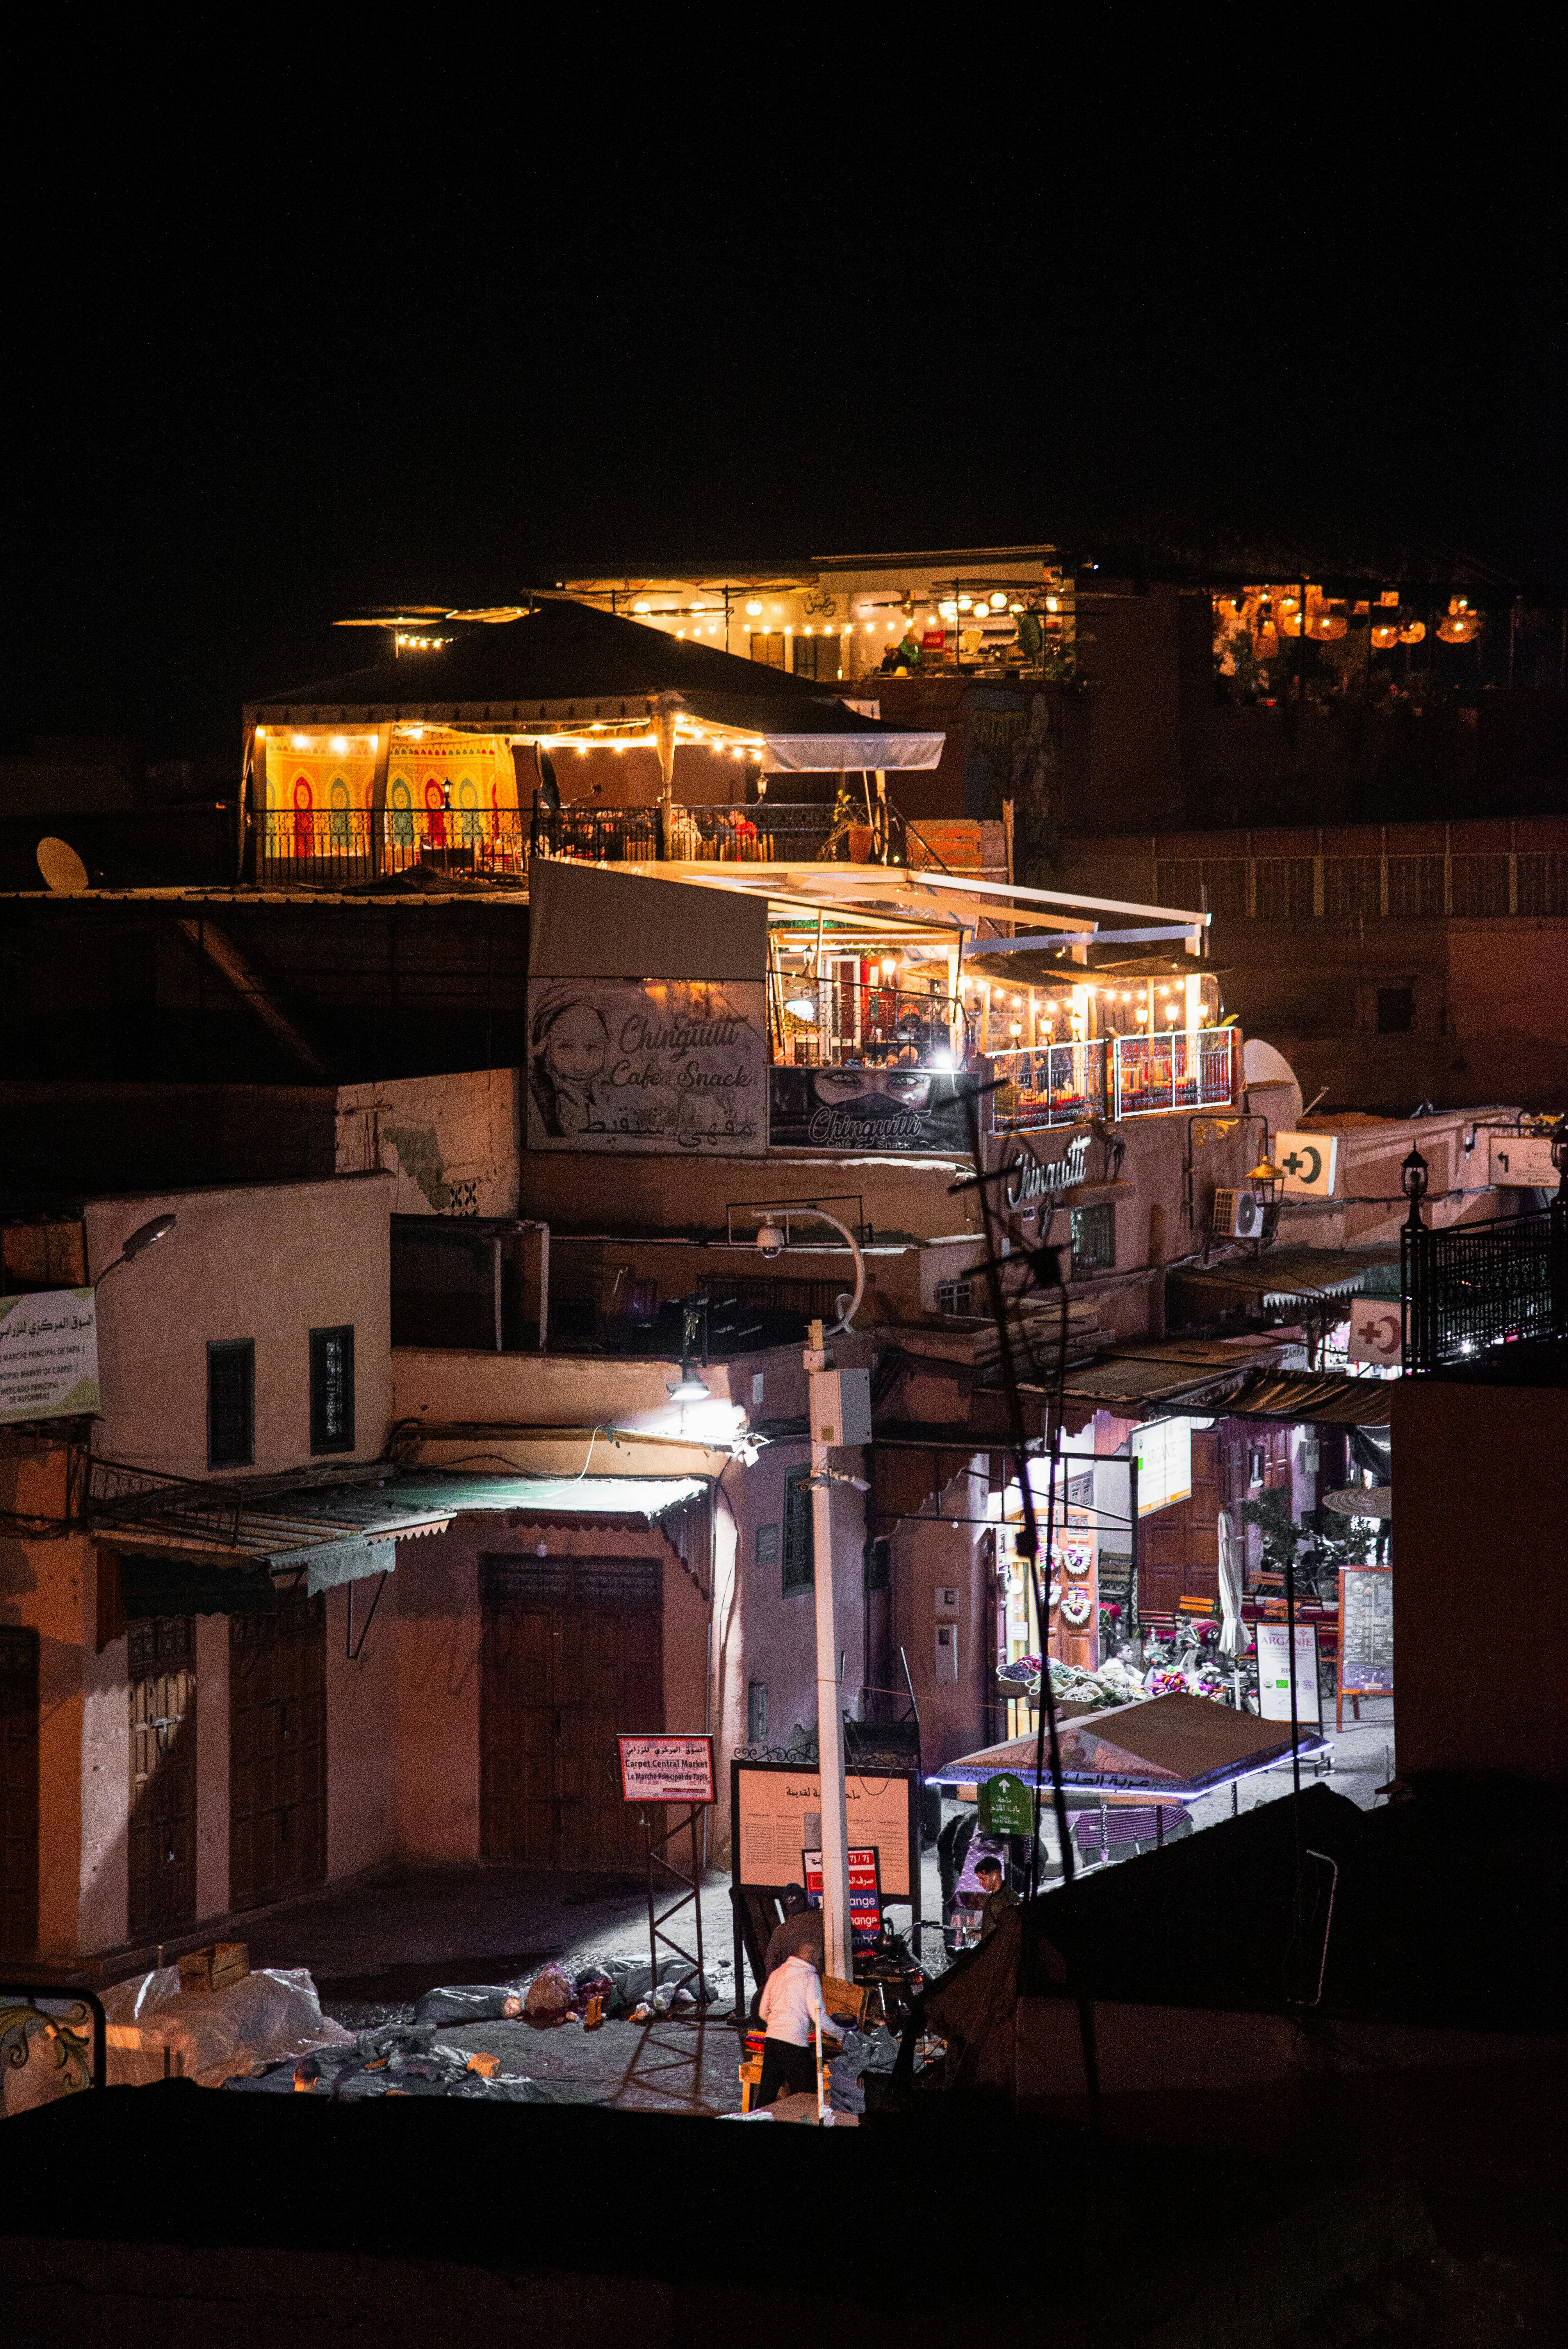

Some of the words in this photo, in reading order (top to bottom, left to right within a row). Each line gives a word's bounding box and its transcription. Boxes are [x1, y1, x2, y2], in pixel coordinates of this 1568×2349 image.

[677, 1060, 752, 1088] Snack
[577, 1103, 665, 1143] شنقيط
[678, 1108, 753, 1147] مقهى
[826, 1139, 852, 1148] Café
[877, 1141, 911, 1149] Snack
[29, 1317, 68, 1338] المركزي
[70, 1314, 94, 1331] السوق
[0, 1321, 27, 1338] للزراب
[626, 1746, 649, 1757] للزرابي
[654, 1746, 681, 1757] المركزي
[685, 1746, 705, 1756] السوق
[625, 1760, 650, 1769] Carpet
[652, 1759, 679, 1768] Central
[849, 1855, 857, 1864] 7j
[862, 1854, 870, 1863] 7j
[856, 1876, 874, 1886] صرف
[850, 1897, 875, 1908] ange
